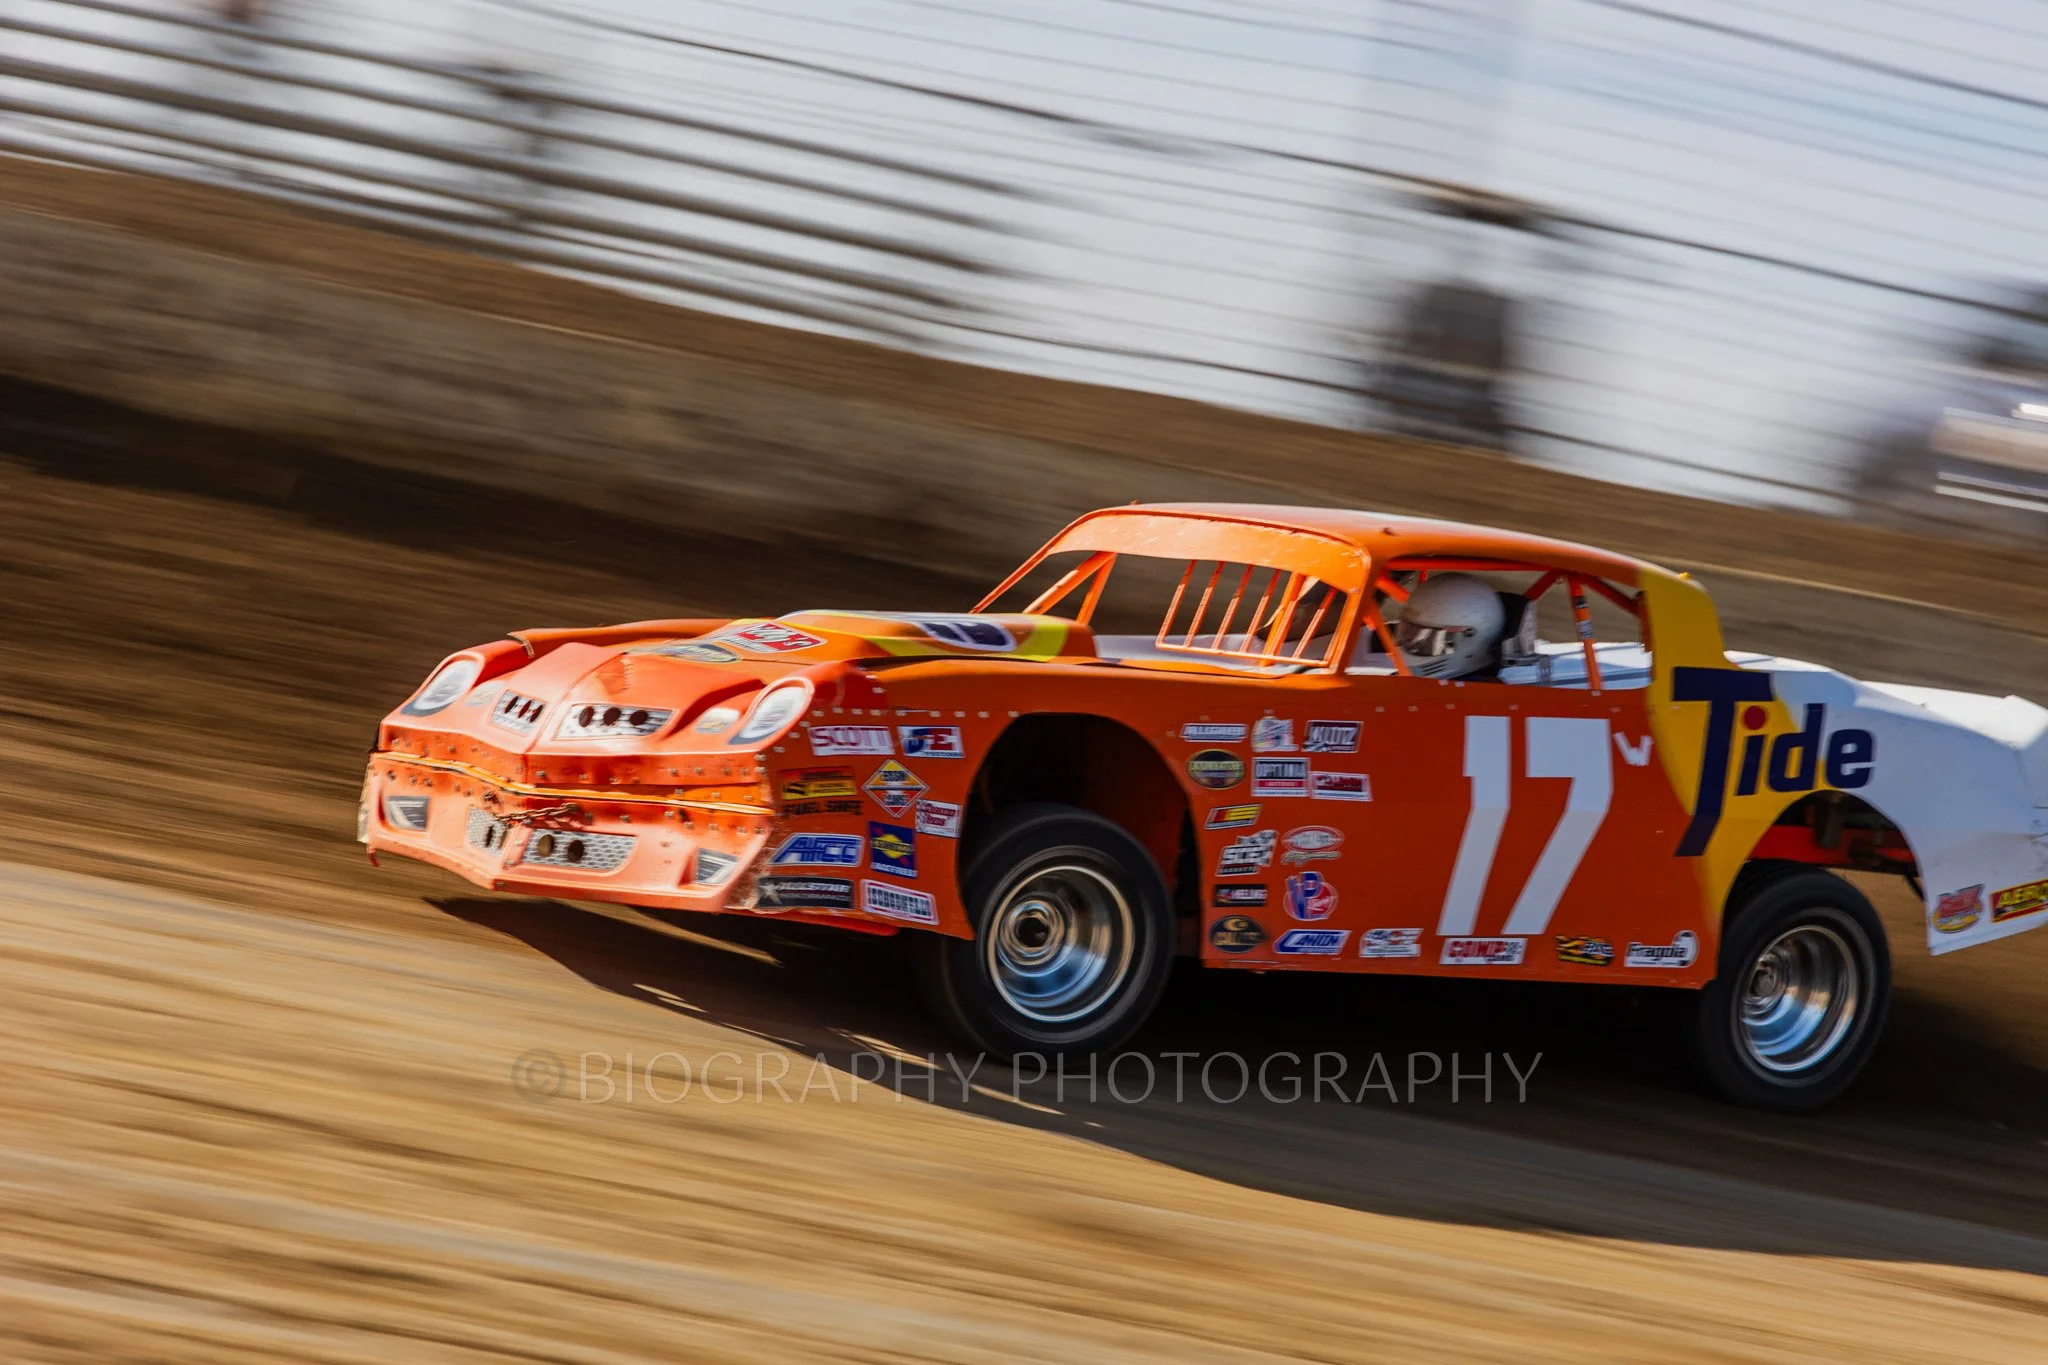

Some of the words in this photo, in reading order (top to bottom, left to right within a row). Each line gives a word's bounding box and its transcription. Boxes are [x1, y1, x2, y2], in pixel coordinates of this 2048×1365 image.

[810, 727, 889, 747] SCOTT
[1437, 715, 1614, 936] 17
[1673, 667, 1876, 857] Tide
